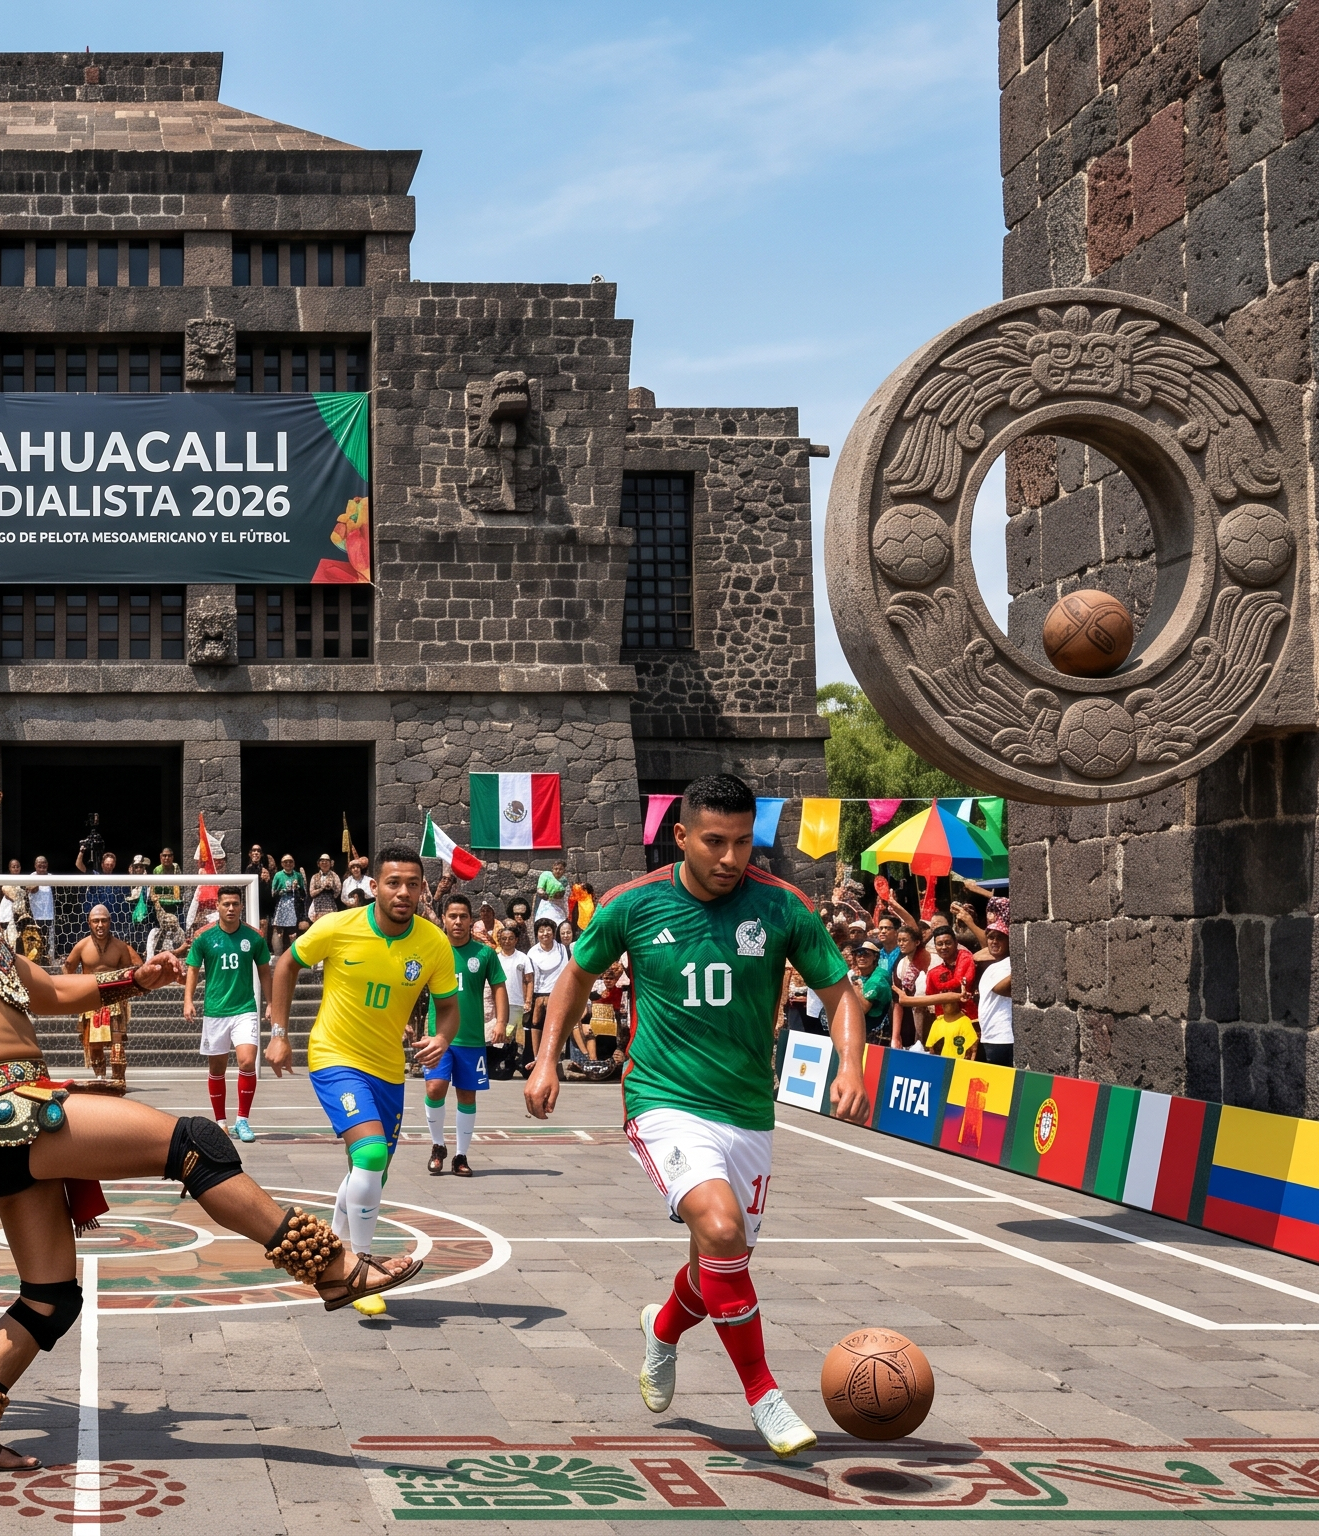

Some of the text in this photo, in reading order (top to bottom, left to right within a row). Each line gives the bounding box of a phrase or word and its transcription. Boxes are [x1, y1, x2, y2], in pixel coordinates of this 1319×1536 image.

[191, 484, 291, 518] 2026
[20, 531, 36, 543] DE
[40, 531, 89, 543] PELOTA
[92, 531, 206, 543] MESOAMERICANO
[209, 531, 219, 543] Y
[222, 531, 237, 543] EL
[239, 528, 291, 543] FÚTBOL
[364, 981, 391, 1010] 10
[682, 962, 732, 1007] 10
[476, 1055, 487, 1075] 4
[889, 1075, 929, 1117] FIFA
[746, 1174, 771, 1215] 1
